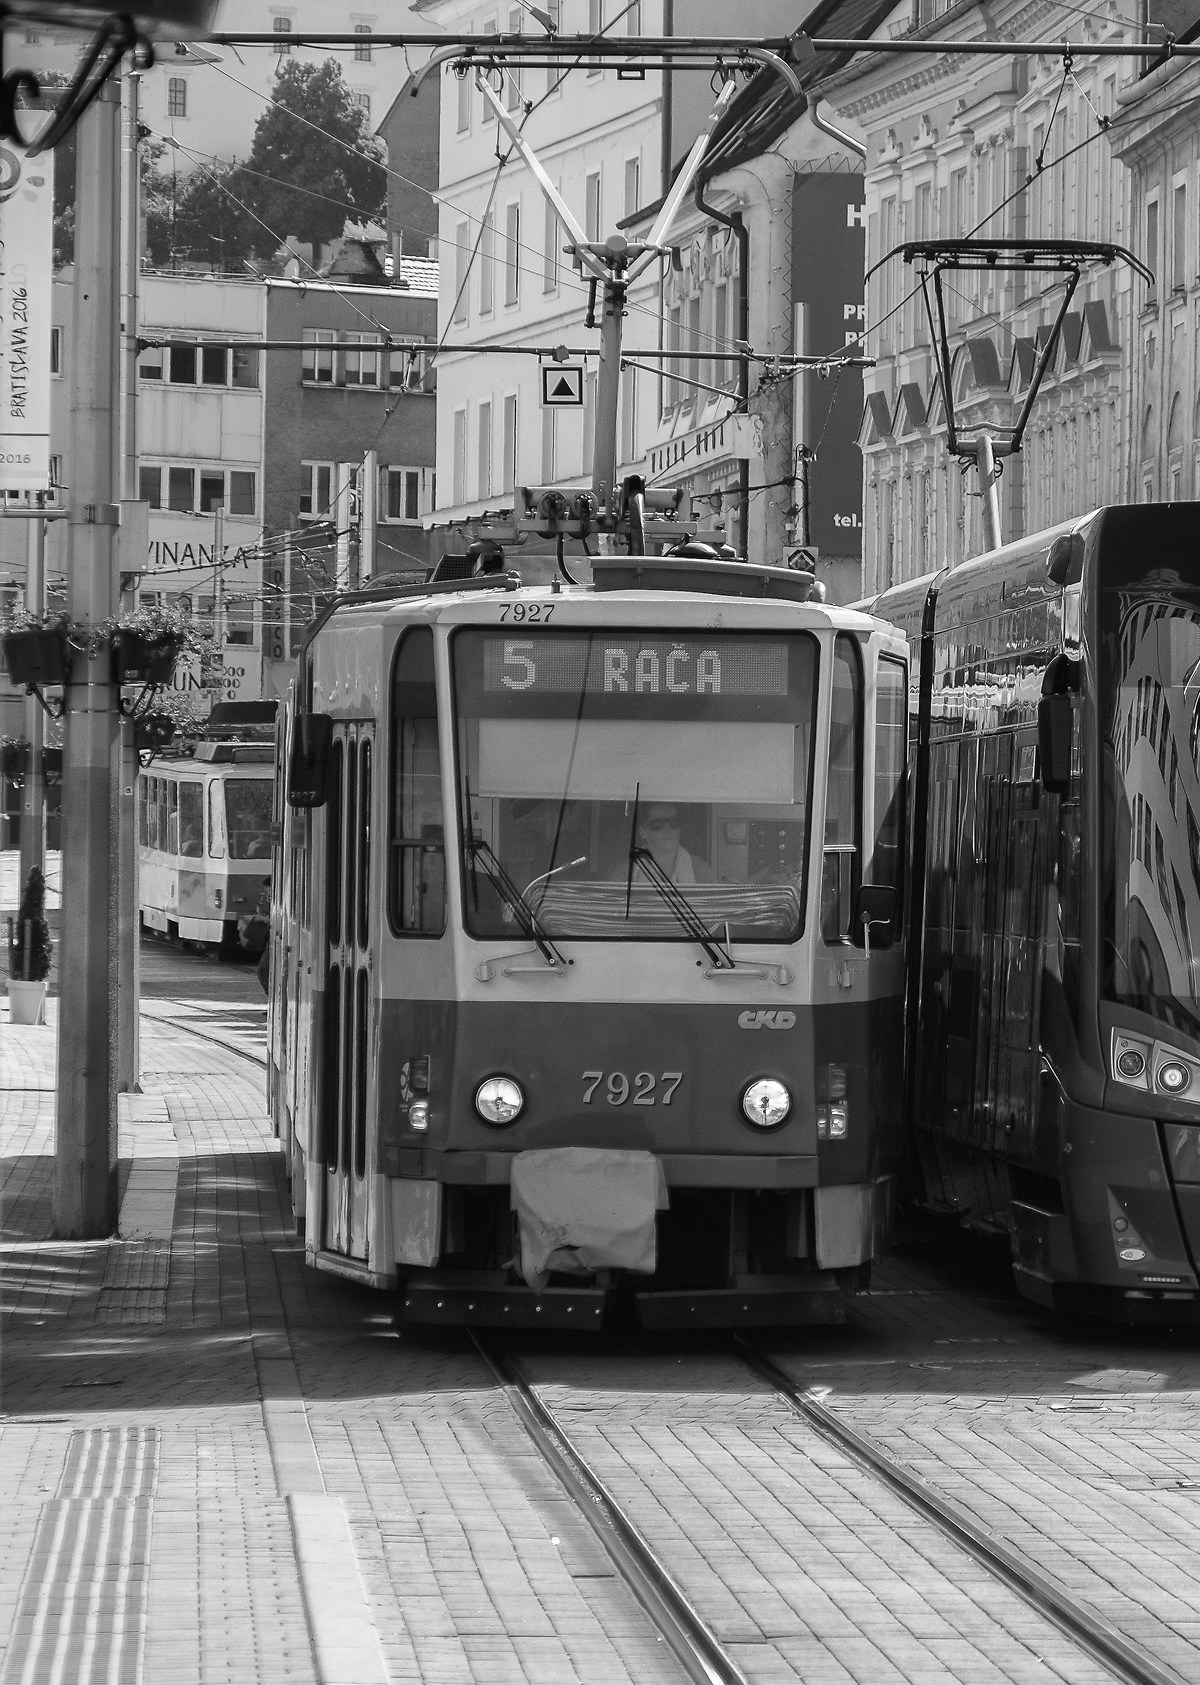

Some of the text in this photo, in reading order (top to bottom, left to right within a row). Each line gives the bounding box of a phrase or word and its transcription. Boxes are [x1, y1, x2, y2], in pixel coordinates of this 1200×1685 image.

[12, 287, 28, 323] 2016
[9, 326, 29, 419] BRATISLAVA
[0, 453, 31, 464] 2016
[833, 513, 862, 527] tel.
[498, 603, 556, 624] 7927
[501, 640, 722, 693] 5 RAČA
[580, 1071, 684, 1107] 7927
